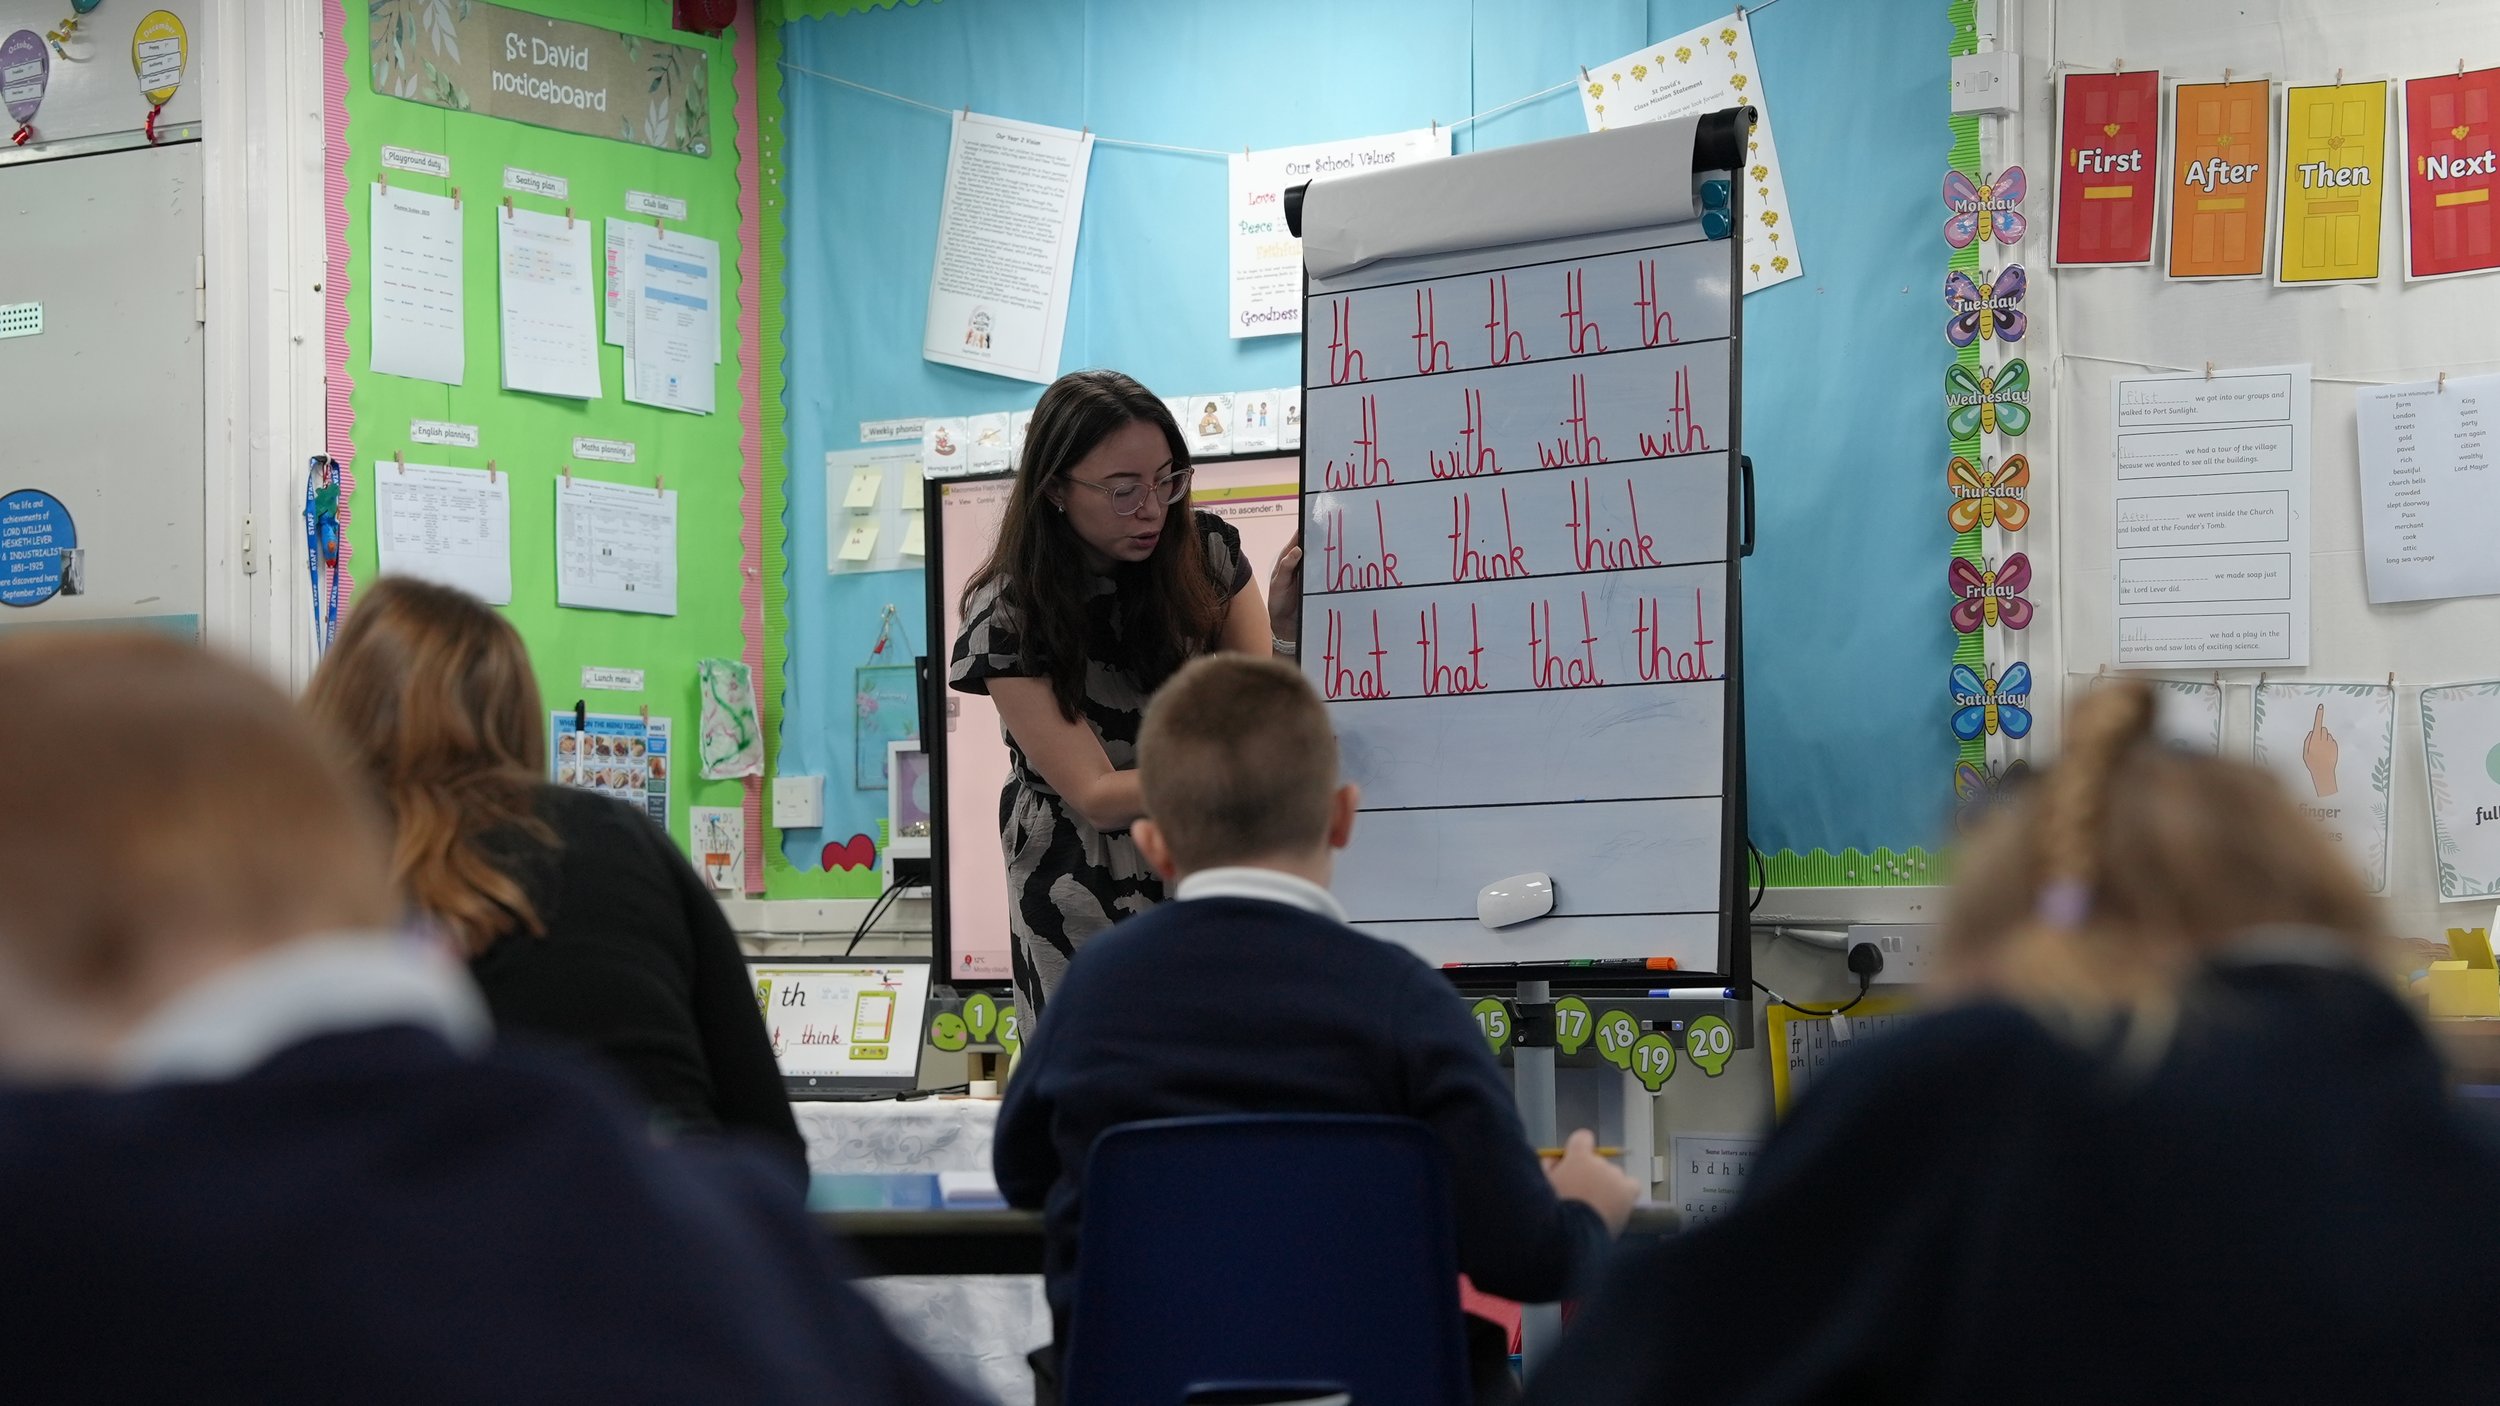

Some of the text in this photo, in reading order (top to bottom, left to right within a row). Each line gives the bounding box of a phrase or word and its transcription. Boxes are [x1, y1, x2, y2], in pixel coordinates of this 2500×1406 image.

[144, 23, 176, 38] December
[8, 40, 34, 54] October
[505, 32, 589, 72] St David
[492, 69, 607, 112] noticeboard
[1660, 80, 1681, 92] David's
[1634, 80, 1703, 112] Class Mission Statement
[996, 132, 1006, 140] Our
[388, 152, 442, 170] Playground duty
[1286, 150, 1396, 176] Our School Values
[2077, 147, 2143, 174] First
[2426, 149, 2497, 181] Next
[2184, 157, 2259, 193] After
[2298, 161, 2371, 189] Then
[515, 174, 556, 192] Seating plan
[643, 198, 669, 211] Club lists
[1248, 192, 1276, 206] Love
[1954, 197, 2016, 214] Monday
[1238, 220, 1273, 236] Peace
[1955, 296, 2017, 312] Tuesday
[1240, 306, 1299, 327] Goodness
[1328, 259, 1680, 386] th th th th th
[1945, 388, 2031, 407] Wednesday
[2206, 394, 2218, 402] got
[2220, 393, 2232, 401] into
[2248, 392, 2270, 402] groups
[2120, 407, 2142, 416] walked
[2152, 407, 2167, 415] Port
[2169, 406, 2199, 416] Sunlight.
[2392, 412, 2416, 420] London
[2460, 408, 2478, 417] queen
[869, 424, 923, 437] Weekly phonics
[1326, 365, 1711, 491] with with with with
[2462, 420, 2478, 428] party
[418, 425, 472, 442] English planning
[2398, 434, 2412, 442] gold
[581, 442, 627, 457] Maths planning
[2197, 446, 2210, 454] had
[2234, 444, 2241, 453] of
[2242, 444, 2253, 452] the
[2254, 442, 2278, 452] village
[2460, 442, 2480, 450] citizen
[2120, 460, 2143, 470] because
[2156, 460, 2181, 468] wanted
[2226, 456, 2259, 466] buildings.
[2400, 456, 2412, 464] rich
[2459, 452, 2484, 462] wealthy
[2393, 466, 2421, 475] beautiful
[2388, 478, 2410, 487] church
[1952, 483, 2025, 500] Thursday
[2394, 488, 2421, 498] crowded
[9, 500, 44, 511] The life and
[1215, 506, 1228, 516] join
[1230, 507, 1236, 515] to
[1276, 504, 1282, 512] th
[2216, 508, 2235, 518] inside
[2237, 508, 2248, 516] the
[2250, 507, 2274, 516] Church
[2, 510, 50, 524] achievements of
[3, 524, 52, 537] LORD WILLIAM
[2394, 522, 2424, 530] merchant
[2, 535, 52, 548] HESKETH LEVER
[1324, 476, 1663, 593] think think think
[10, 547, 63, 560] INDUSTRIALIST
[2402, 544, 2417, 552] attic
[12, 574, 58, 586] discovered here
[2226, 570, 2246, 579] made
[2246, 571, 2262, 581] soap
[2263, 570, 2278, 580] just
[2, 586, 52, 600] September 2025
[1965, 584, 2015, 600] Friday
[1323, 587, 1714, 700] that that that that
[594, 673, 631, 684] Lunch menu
[1956, 691, 2027, 708] Saturday
[782, 982, 806, 1007] th
[974, 1004, 984, 1028] 1
[1556, 1009, 1586, 1038] 17
[1005, 1016, 1018, 1040] 2
[1476, 1010, 1505, 1039] 15
[1792, 1022, 1798, 1037] f
[1860, 1020, 1866, 1030] n
[802, 1024, 840, 1046] think
[1600, 1020, 1635, 1051] 18
[1692, 1025, 1731, 1058] 20
[1792, 1038, 1822, 1054] ff ll
[1637, 1044, 1670, 1076] 19
[1790, 1056, 1825, 1071] ph le
[1692, 1160, 1744, 1176] b d h k
[1686, 1203, 1718, 1213] a c e
